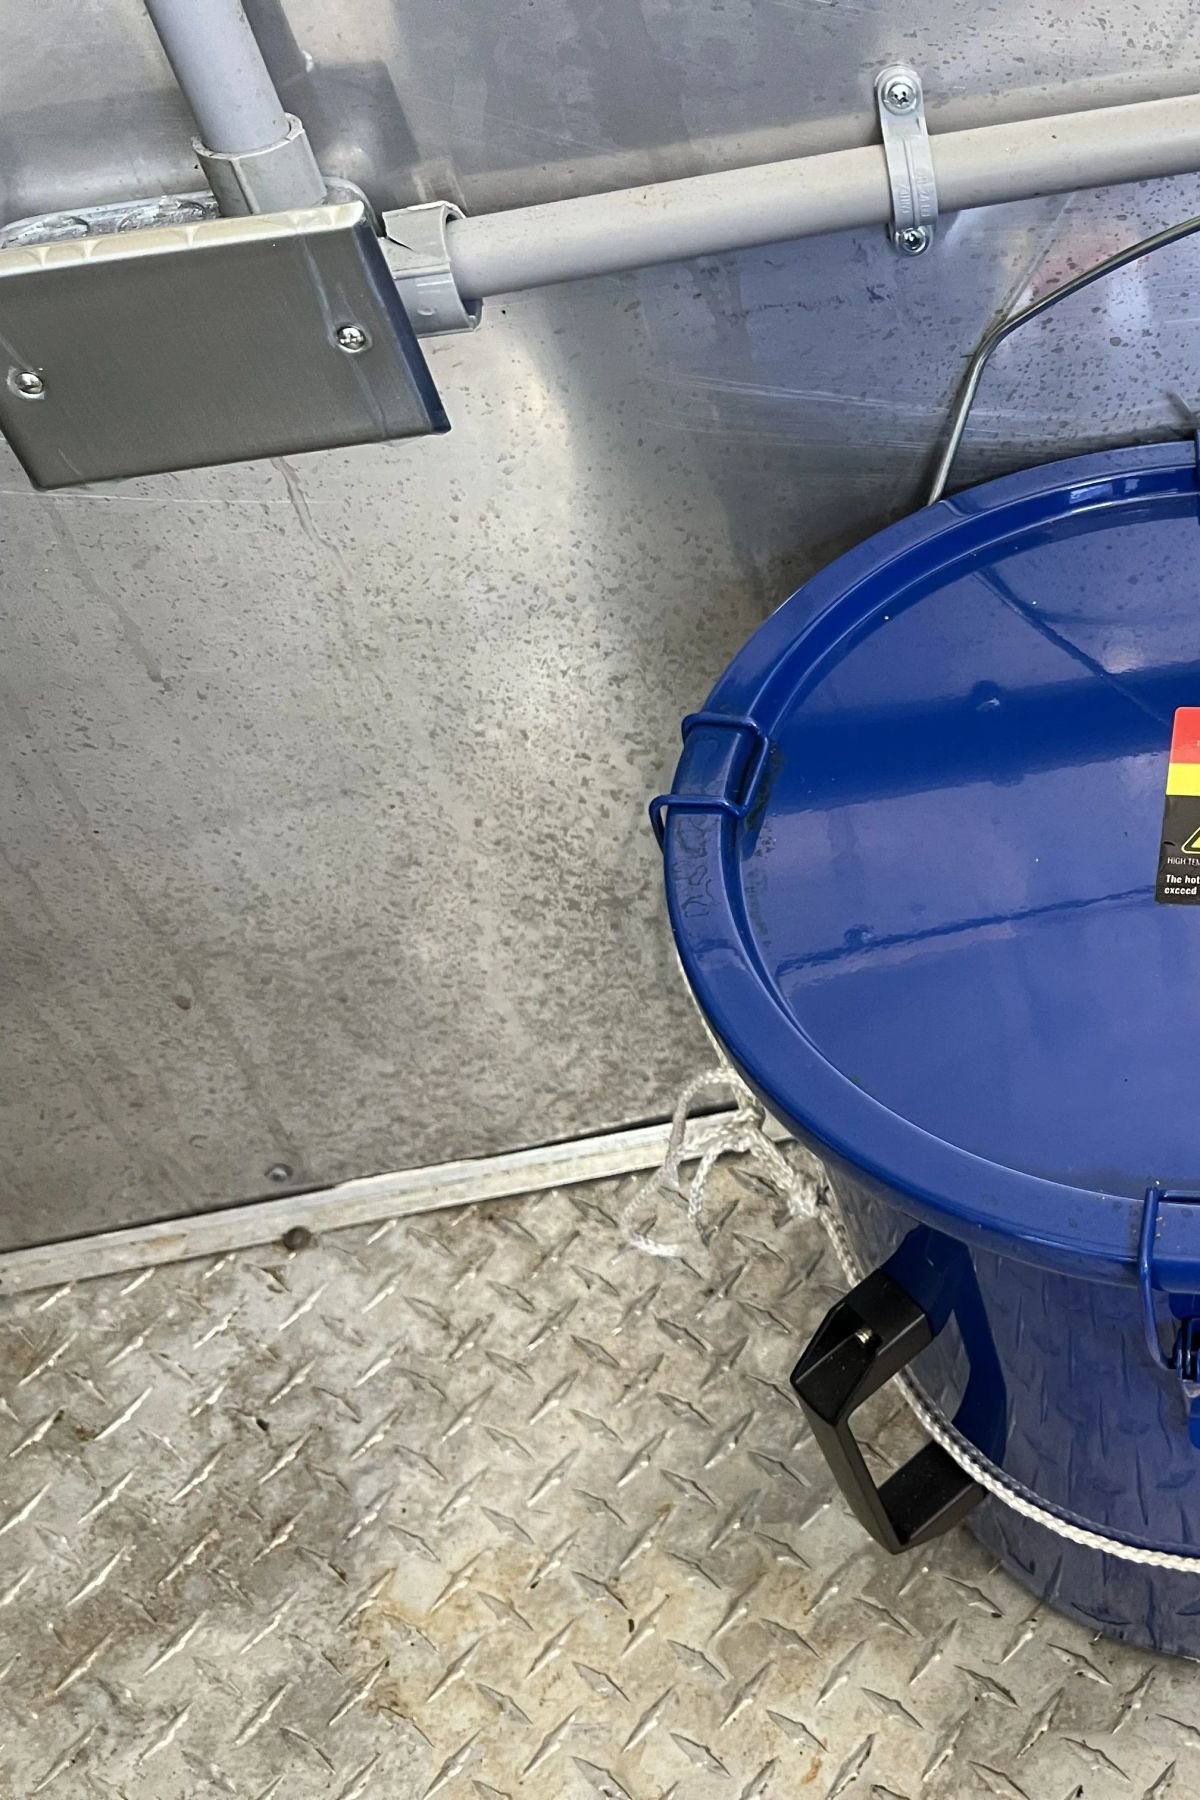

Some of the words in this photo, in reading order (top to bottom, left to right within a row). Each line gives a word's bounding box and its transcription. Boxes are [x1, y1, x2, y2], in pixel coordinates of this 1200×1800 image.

[1167, 857, 1186, 865] HIGH
[1166, 875, 1182, 884] The
[1184, 875, 1200, 885] hot
[1164, 886, 1197, 895] exceed
